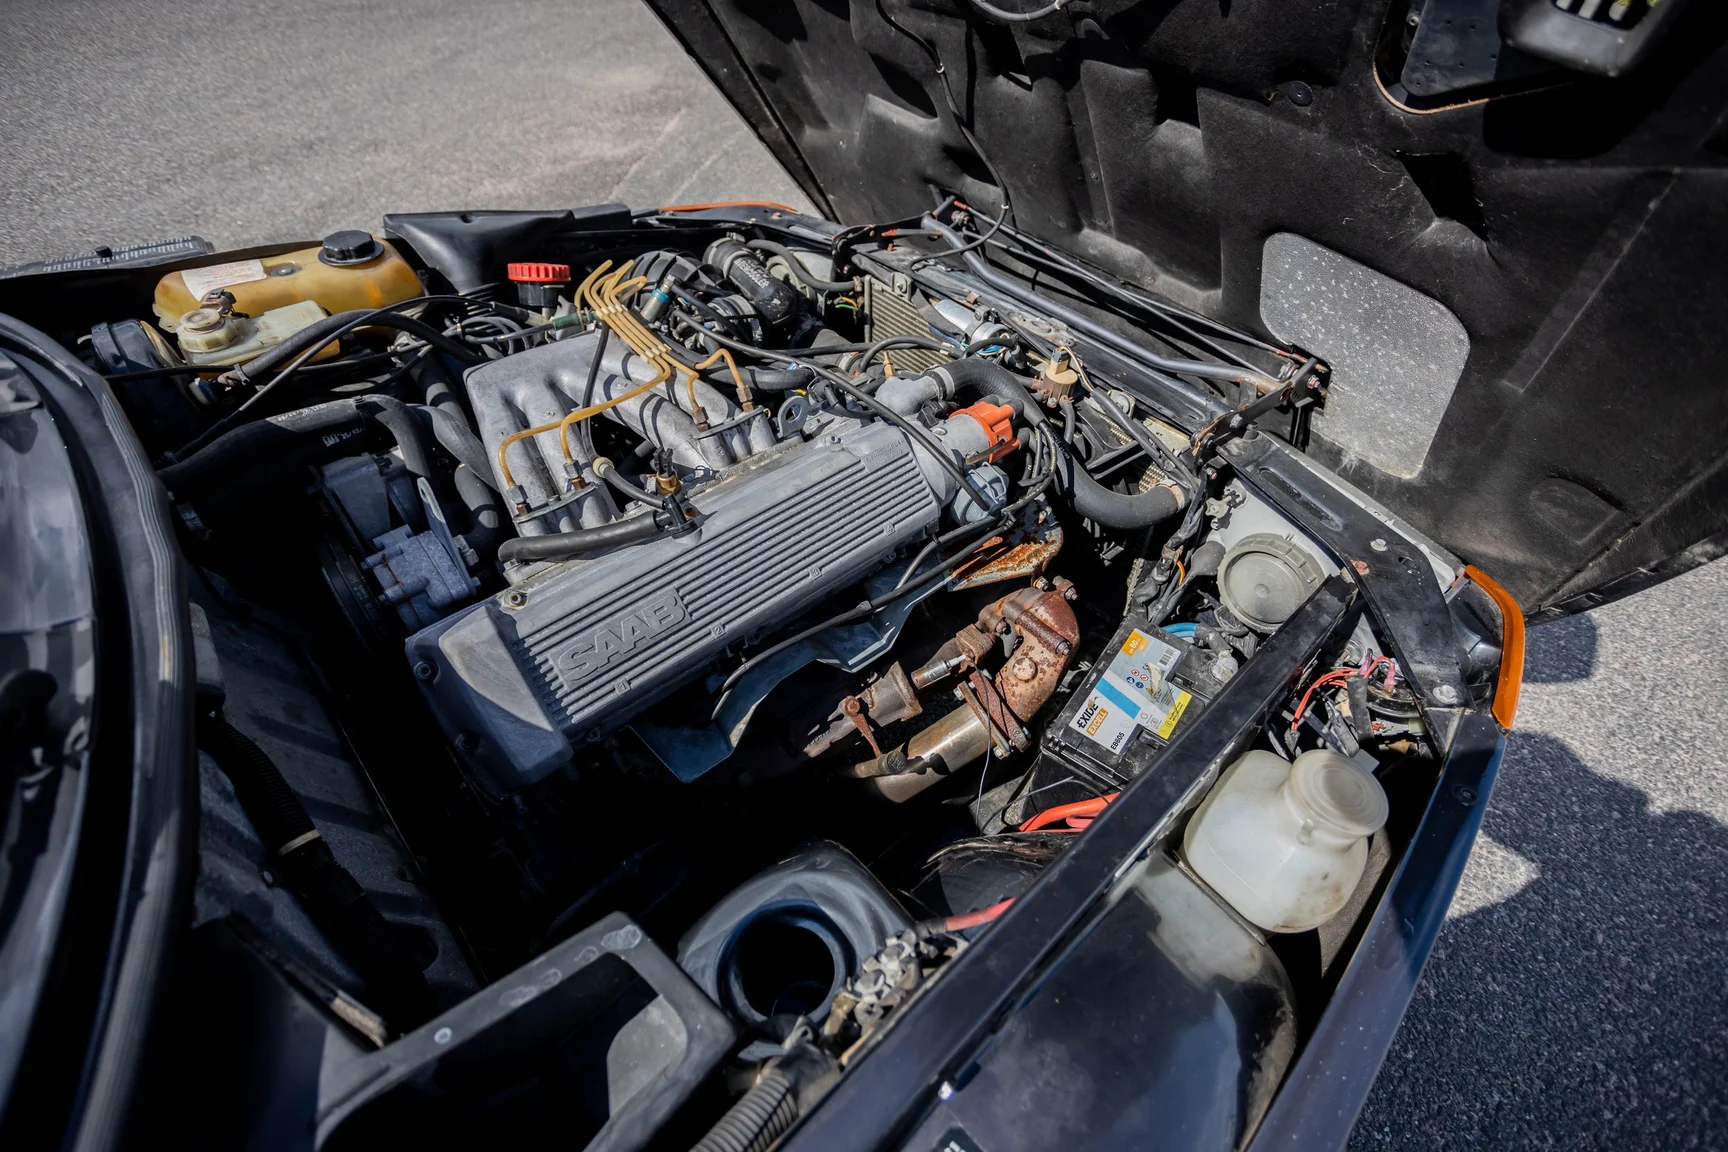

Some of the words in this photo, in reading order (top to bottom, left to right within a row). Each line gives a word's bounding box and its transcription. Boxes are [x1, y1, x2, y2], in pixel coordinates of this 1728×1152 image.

[558, 595, 687, 682] SAAB
[1089, 710, 1107, 733] EXCELL
[1110, 731, 1125, 751] EB605
